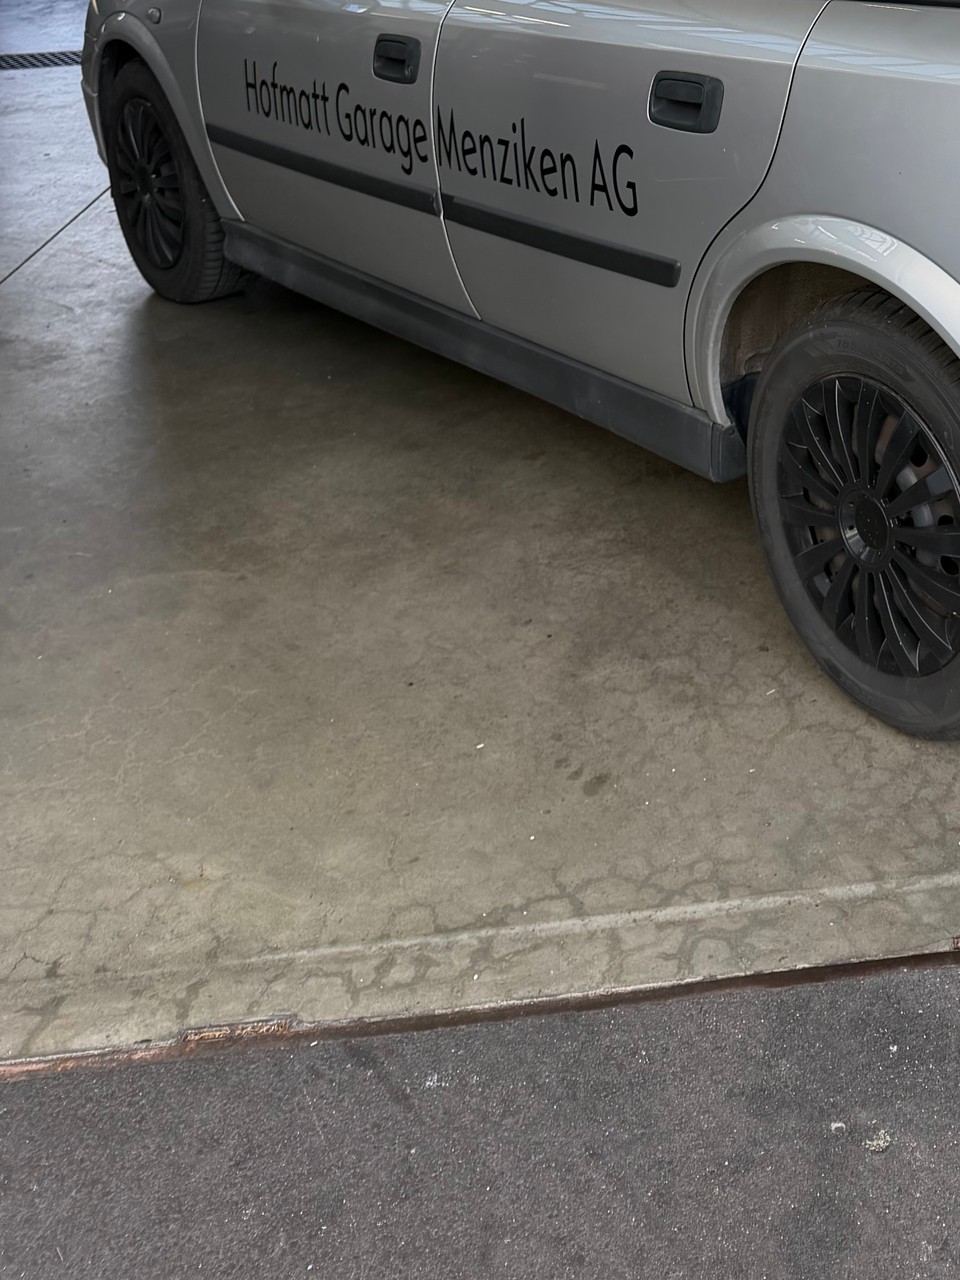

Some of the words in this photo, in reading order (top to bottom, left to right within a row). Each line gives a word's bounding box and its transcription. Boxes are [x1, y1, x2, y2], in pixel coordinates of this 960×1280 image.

[244, 58, 331, 136] Hofmatt
[336, 82, 429, 176] Garage
[437, 104, 580, 204] Menziken
[589, 138, 639, 217] AG
